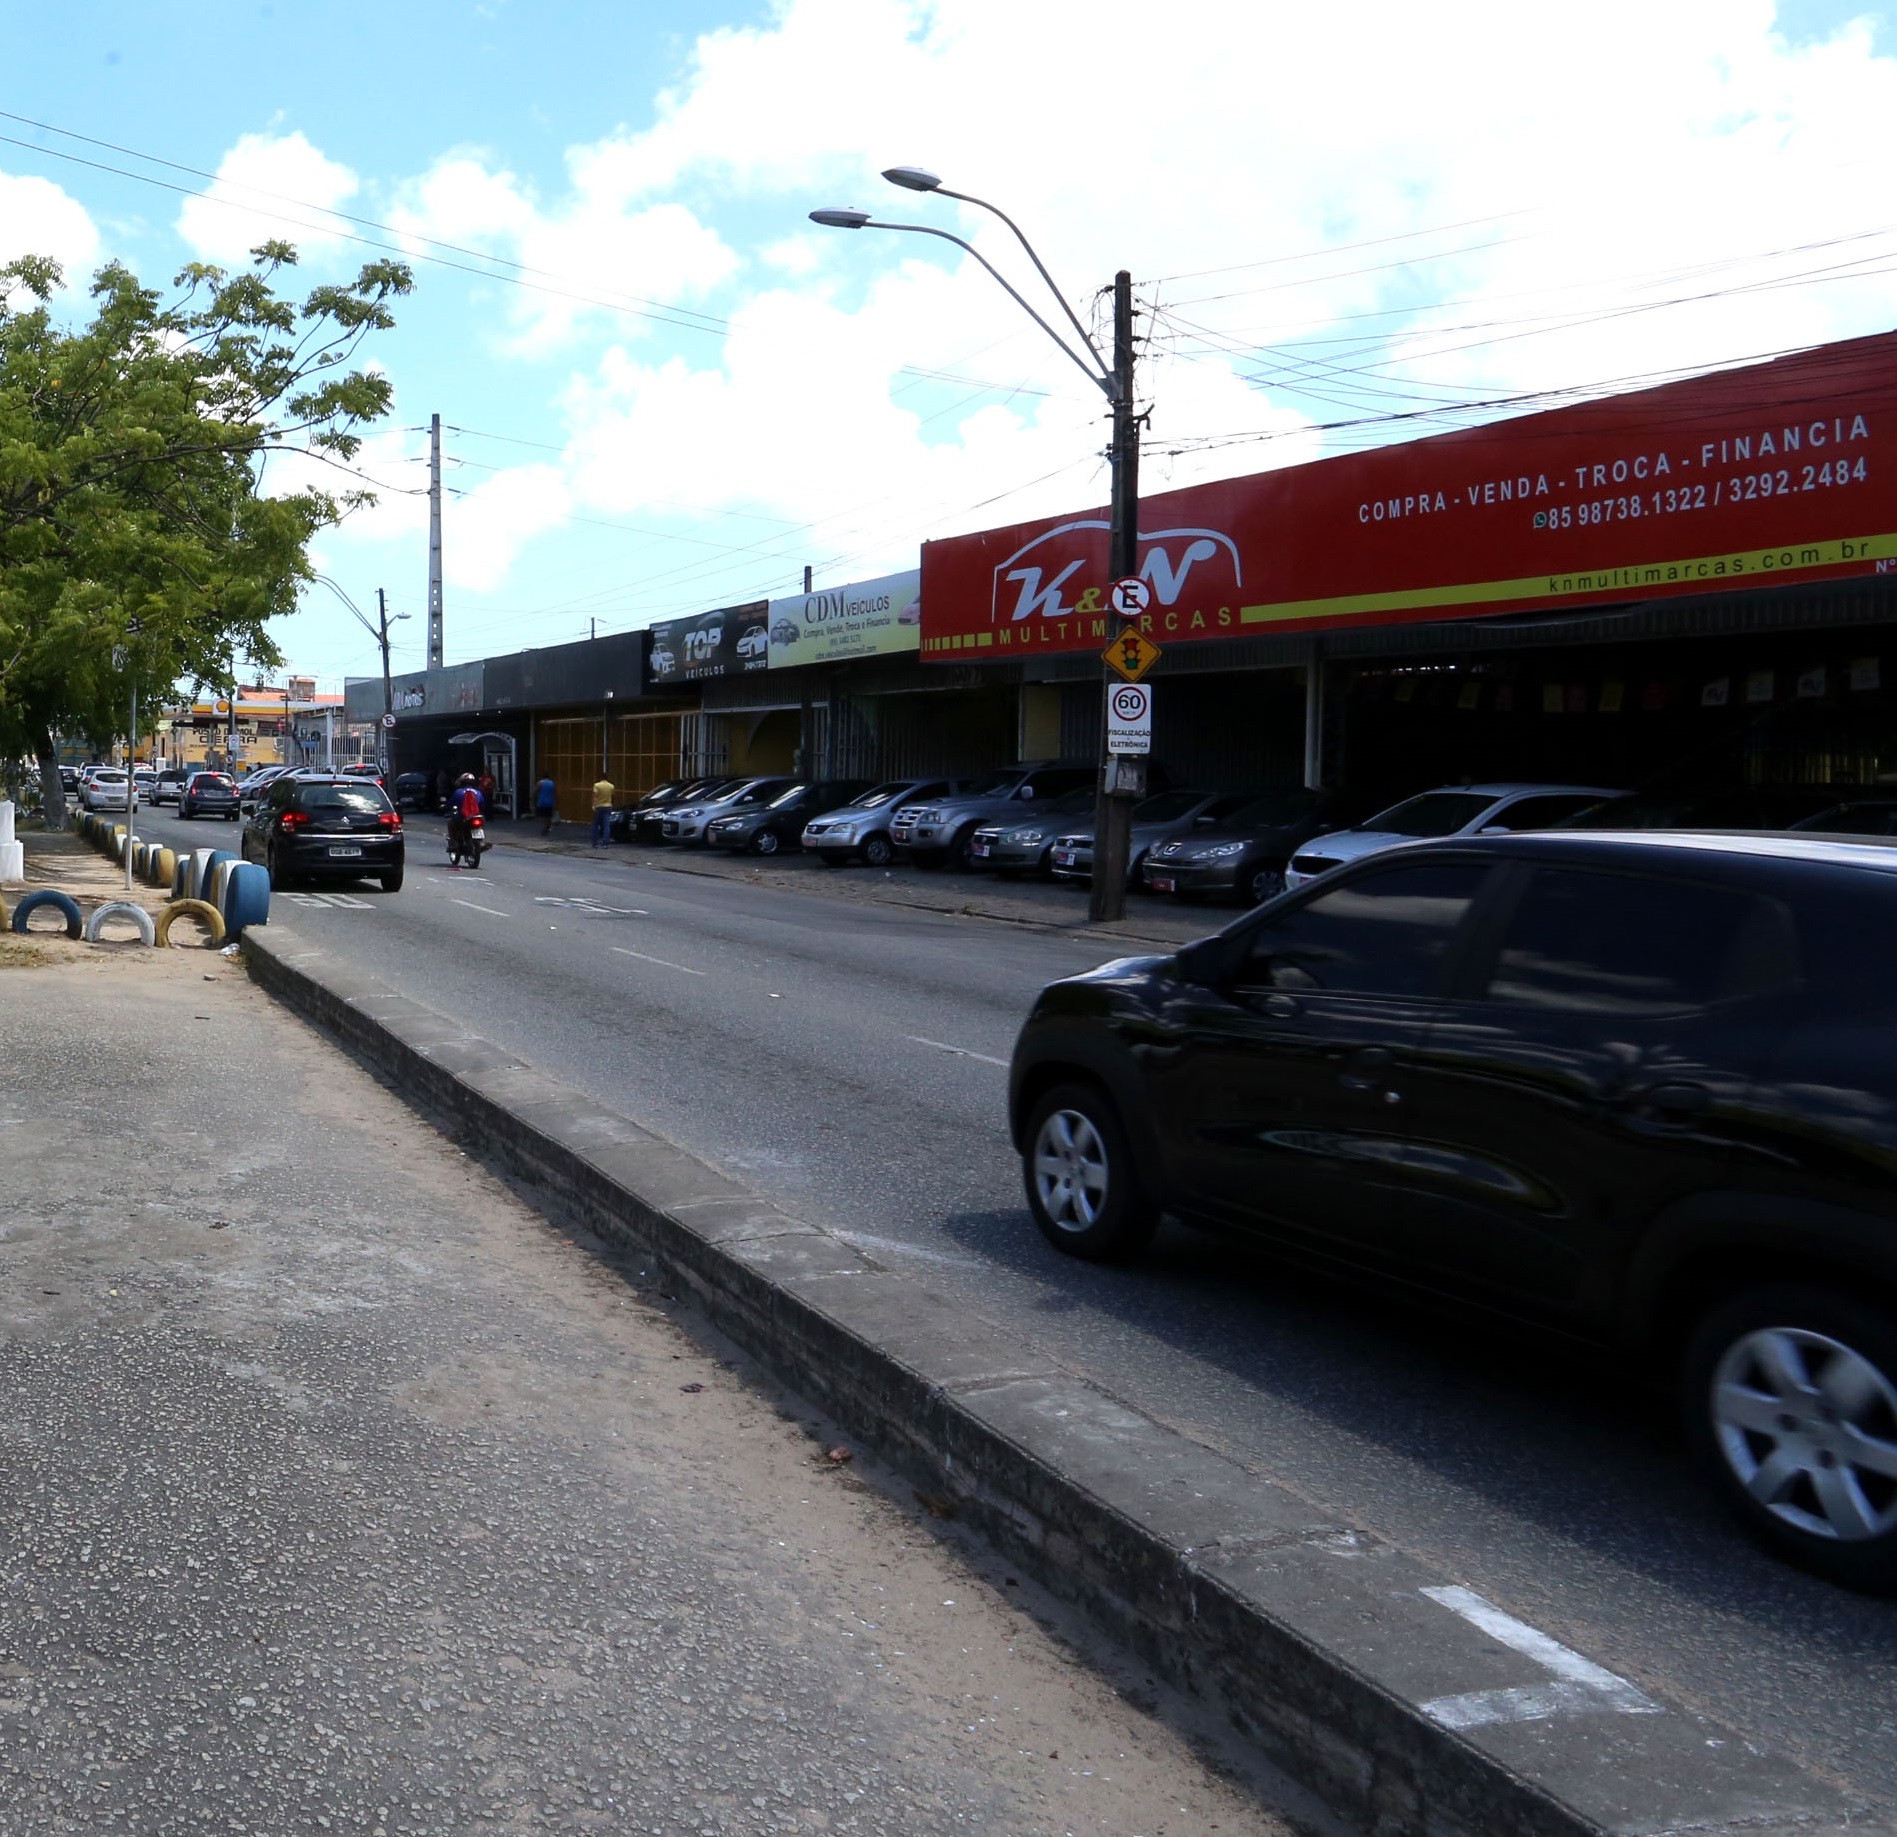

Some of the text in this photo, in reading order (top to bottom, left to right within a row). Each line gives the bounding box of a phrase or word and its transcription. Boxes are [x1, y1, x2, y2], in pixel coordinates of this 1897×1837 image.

[1359, 492, 1446, 523] COMPRA
[1467, 473, 1549, 507] VENDA
[1576, 452, 1670, 489] TROCA
[1701, 414, 1869, 468] FINANCIA
[1548, 505, 1572, 530] 85
[1577, 485, 1706, 526] 98738.1322
[1729, 456, 1868, 503] 3292.2484
[1548, 540, 1870, 594] knmultimarcas.com.br
[805, 591, 844, 624] CDM
[999, 606, 1232, 646] MULTIMRCAS
[684, 626, 722, 662] TOP
[1117, 694, 1141, 710] 60
